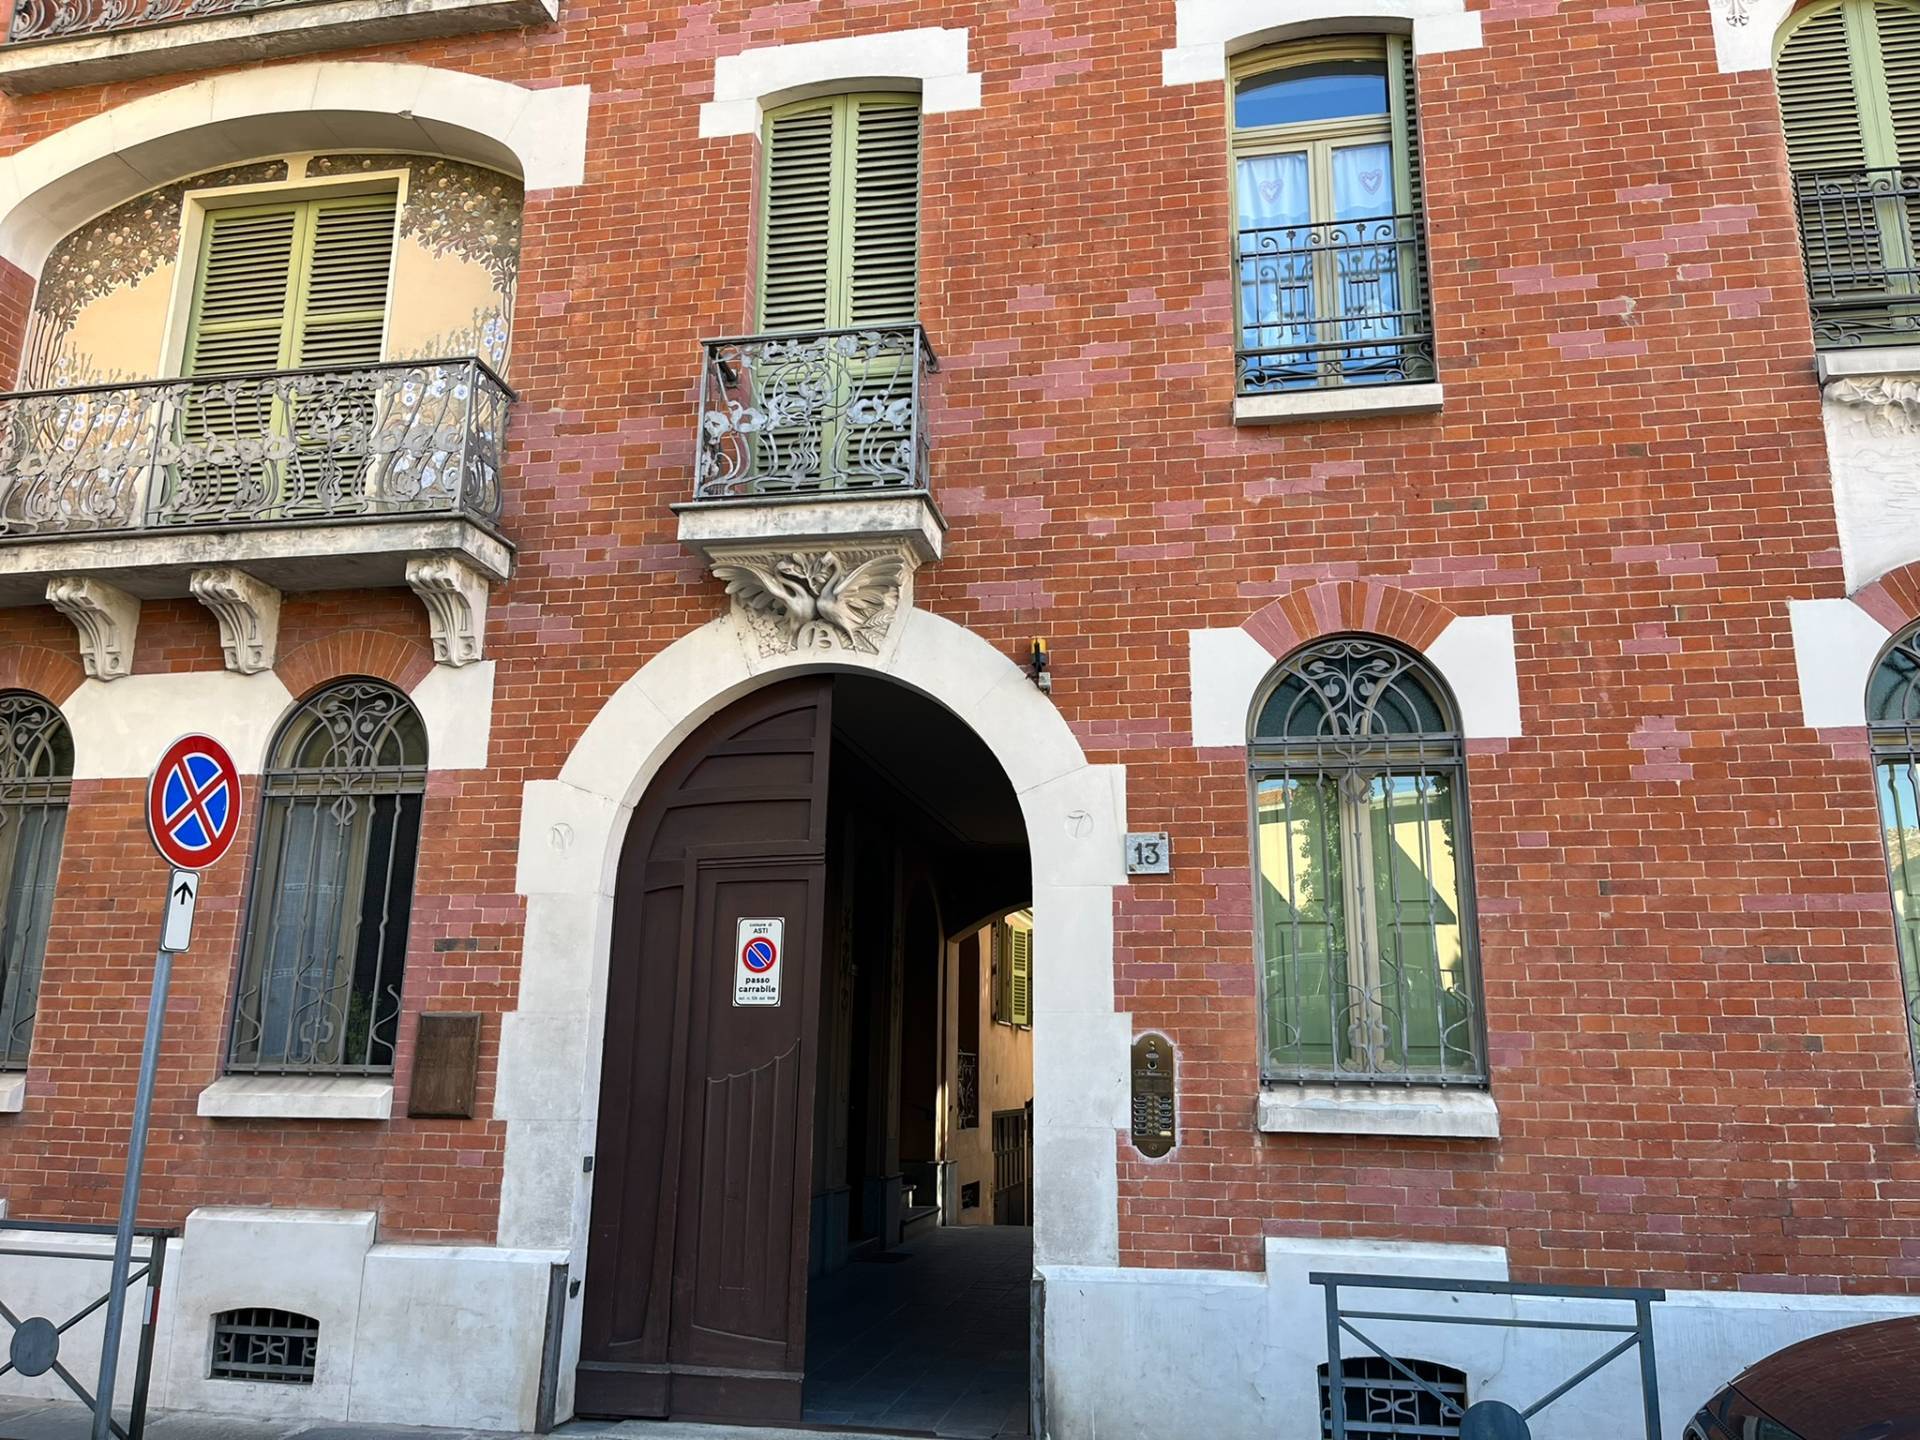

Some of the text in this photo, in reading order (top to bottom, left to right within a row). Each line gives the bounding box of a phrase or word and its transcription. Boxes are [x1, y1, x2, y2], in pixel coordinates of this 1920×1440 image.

[1134, 842, 1160, 865] 13
[745, 977, 770, 985] passo
[738, 985, 776, 993] carrabile
